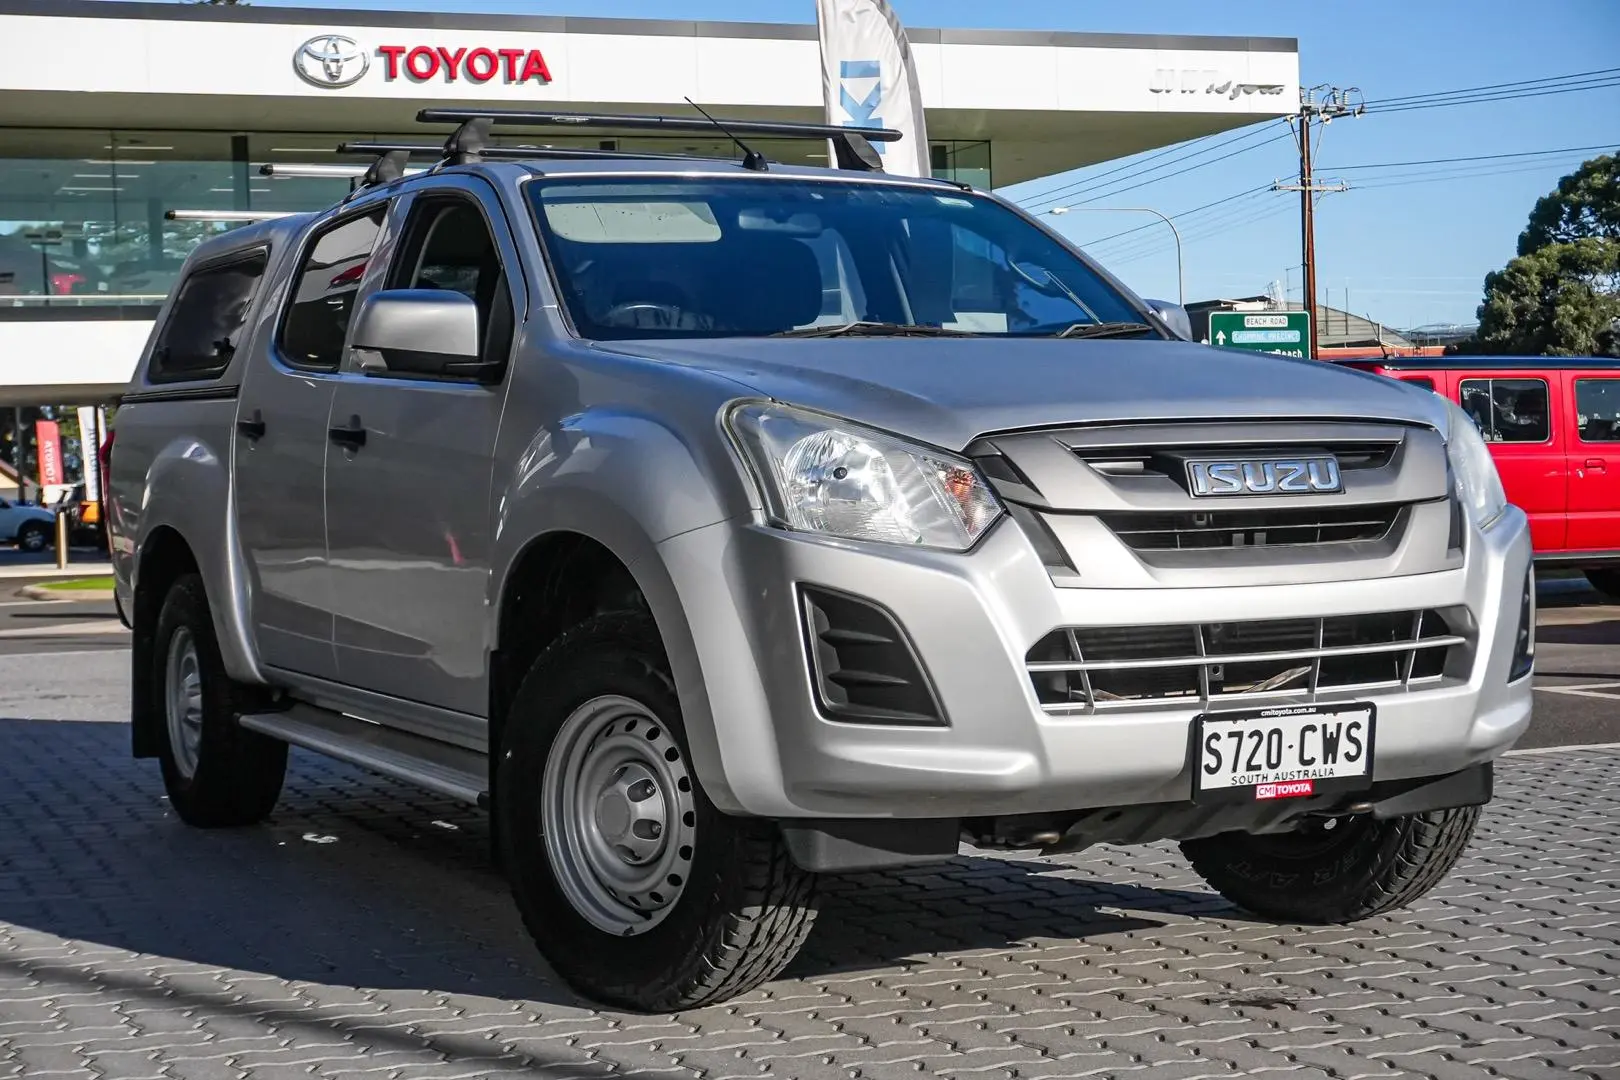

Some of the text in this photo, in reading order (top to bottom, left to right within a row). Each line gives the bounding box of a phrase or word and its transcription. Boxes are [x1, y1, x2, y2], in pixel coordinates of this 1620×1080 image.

[378, 45, 553, 83] TOYOTA
[1246, 317, 1287, 326] BEACH ROAD
[1192, 460, 1339, 494] ISUZU
[1260, 706, 1317, 717] cmitoyota.com.au
[1231, 767, 1335, 786] SOUTH AUSTRALIA
[1257, 783, 1312, 797] CMI TOYOTA
